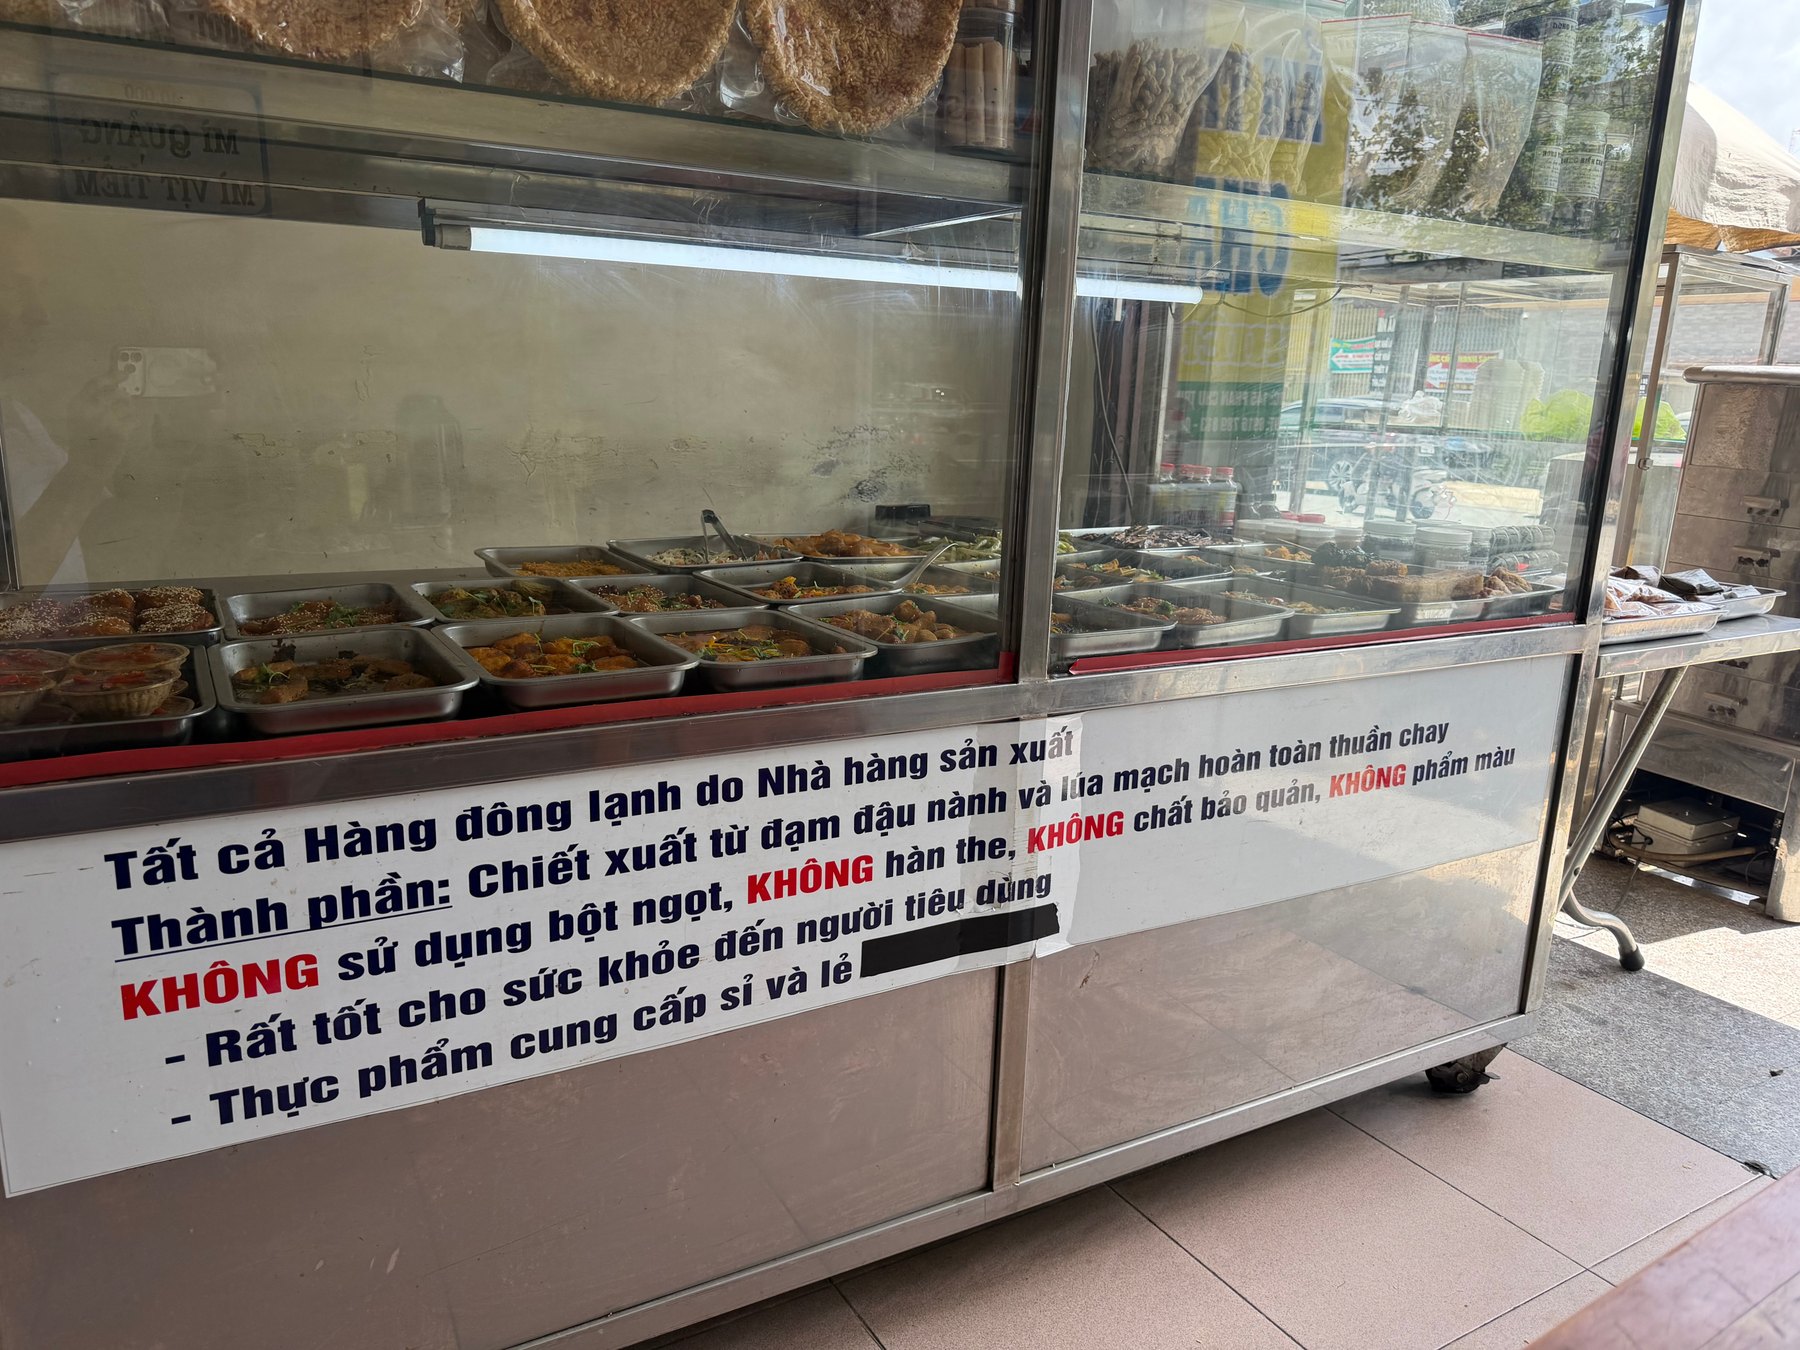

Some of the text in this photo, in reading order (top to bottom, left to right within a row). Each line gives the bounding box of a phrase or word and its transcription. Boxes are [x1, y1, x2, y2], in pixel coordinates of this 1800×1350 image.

[104, 726, 1074, 891] Tất cả Hàng đông lạnh do Nhà hàng sản xuất
[112, 721, 1449, 957] Thành phần: Chiết xuất từ đạm đậu nành và lúa mạch hoàn toàn thuần chay
[121, 745, 1516, 1021] KHÔNG sử dụng bột ngọt, KHÔNG hàn the, KHÔNG chất bảo quản, KHÔNG phẩm màu
[165, 872, 1052, 1068] - Rất tốt cho sức khỏe đến người tiêu dùng
[172, 953, 853, 1126] - Thực phẩm cung cấp sỉ và lẻ
